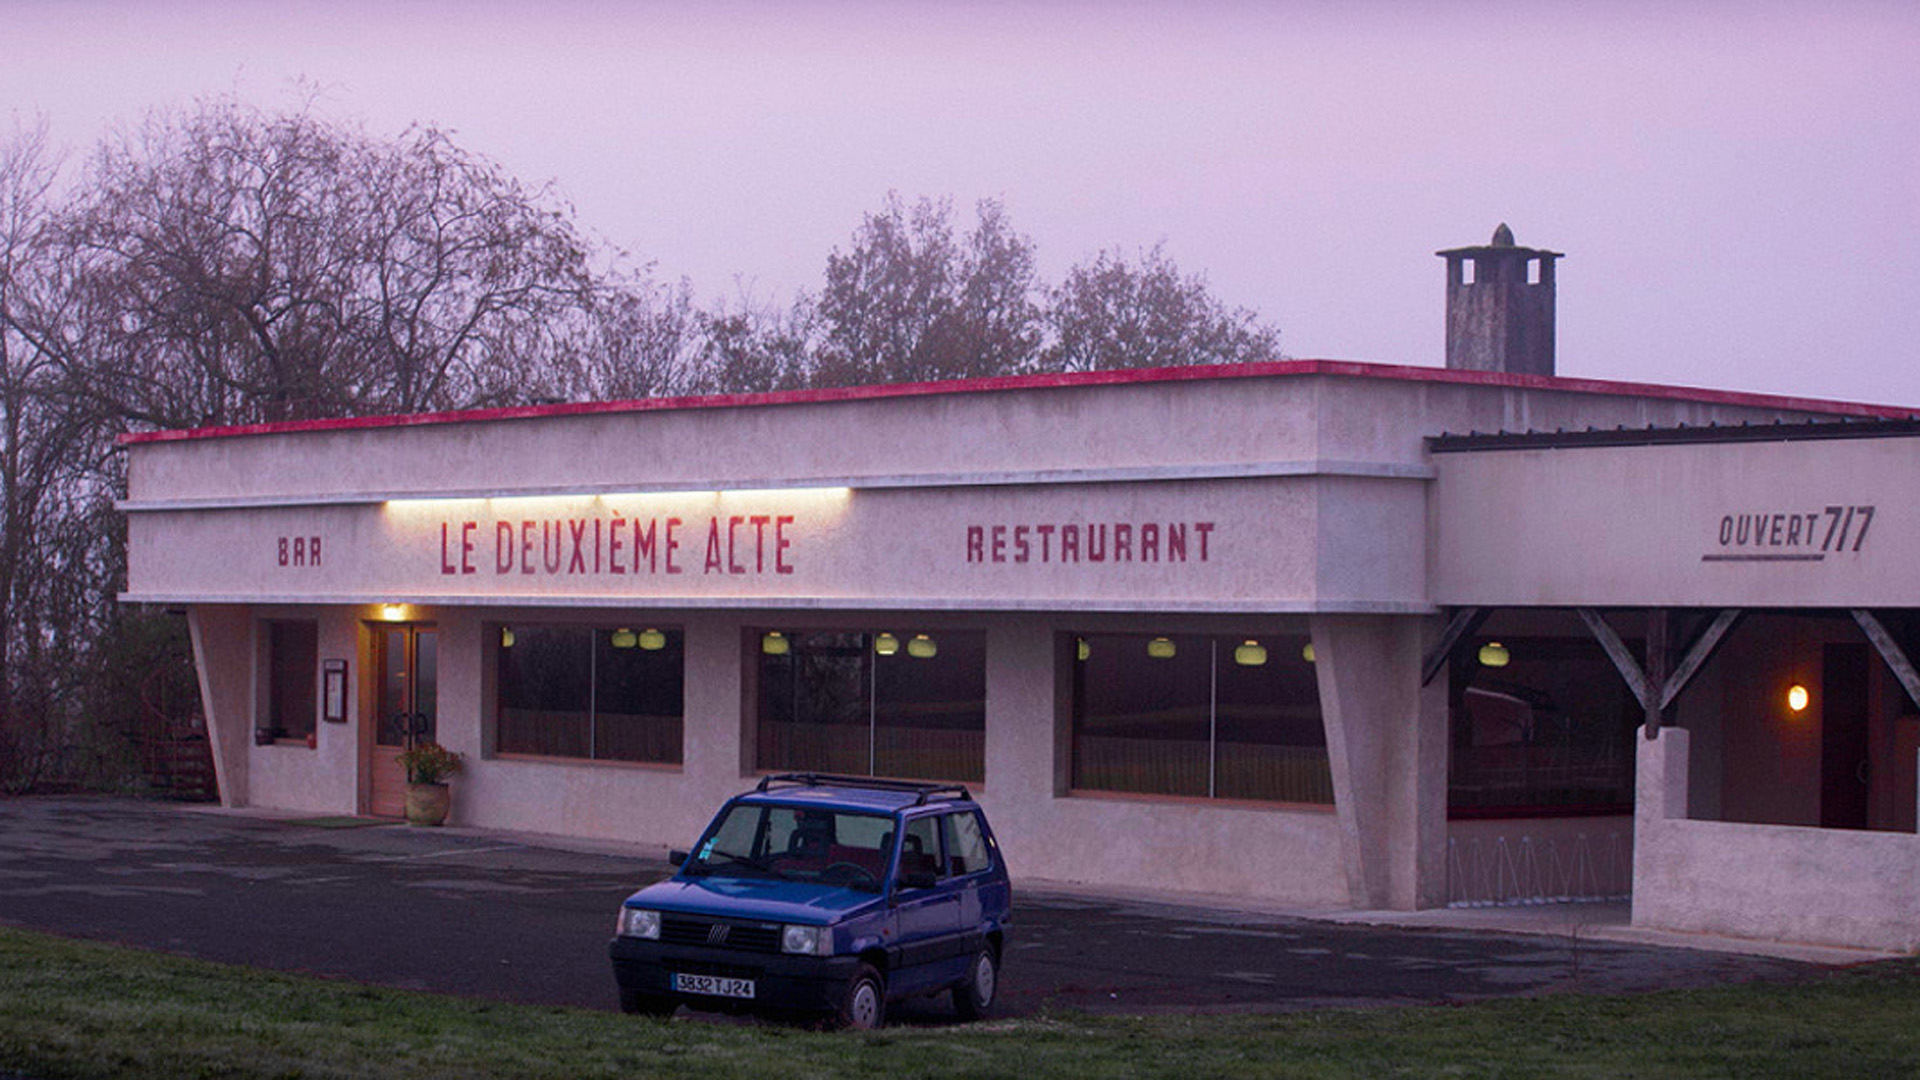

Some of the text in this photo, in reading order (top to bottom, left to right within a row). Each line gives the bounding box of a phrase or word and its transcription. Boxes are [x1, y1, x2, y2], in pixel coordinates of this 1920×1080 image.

[441, 509, 795, 575] LE DEUXIÈME ACTE
[967, 523, 1214, 563] RESTAURANT
[1719, 514, 1819, 546] OUVERT
[278, 537, 322, 567] BAR
